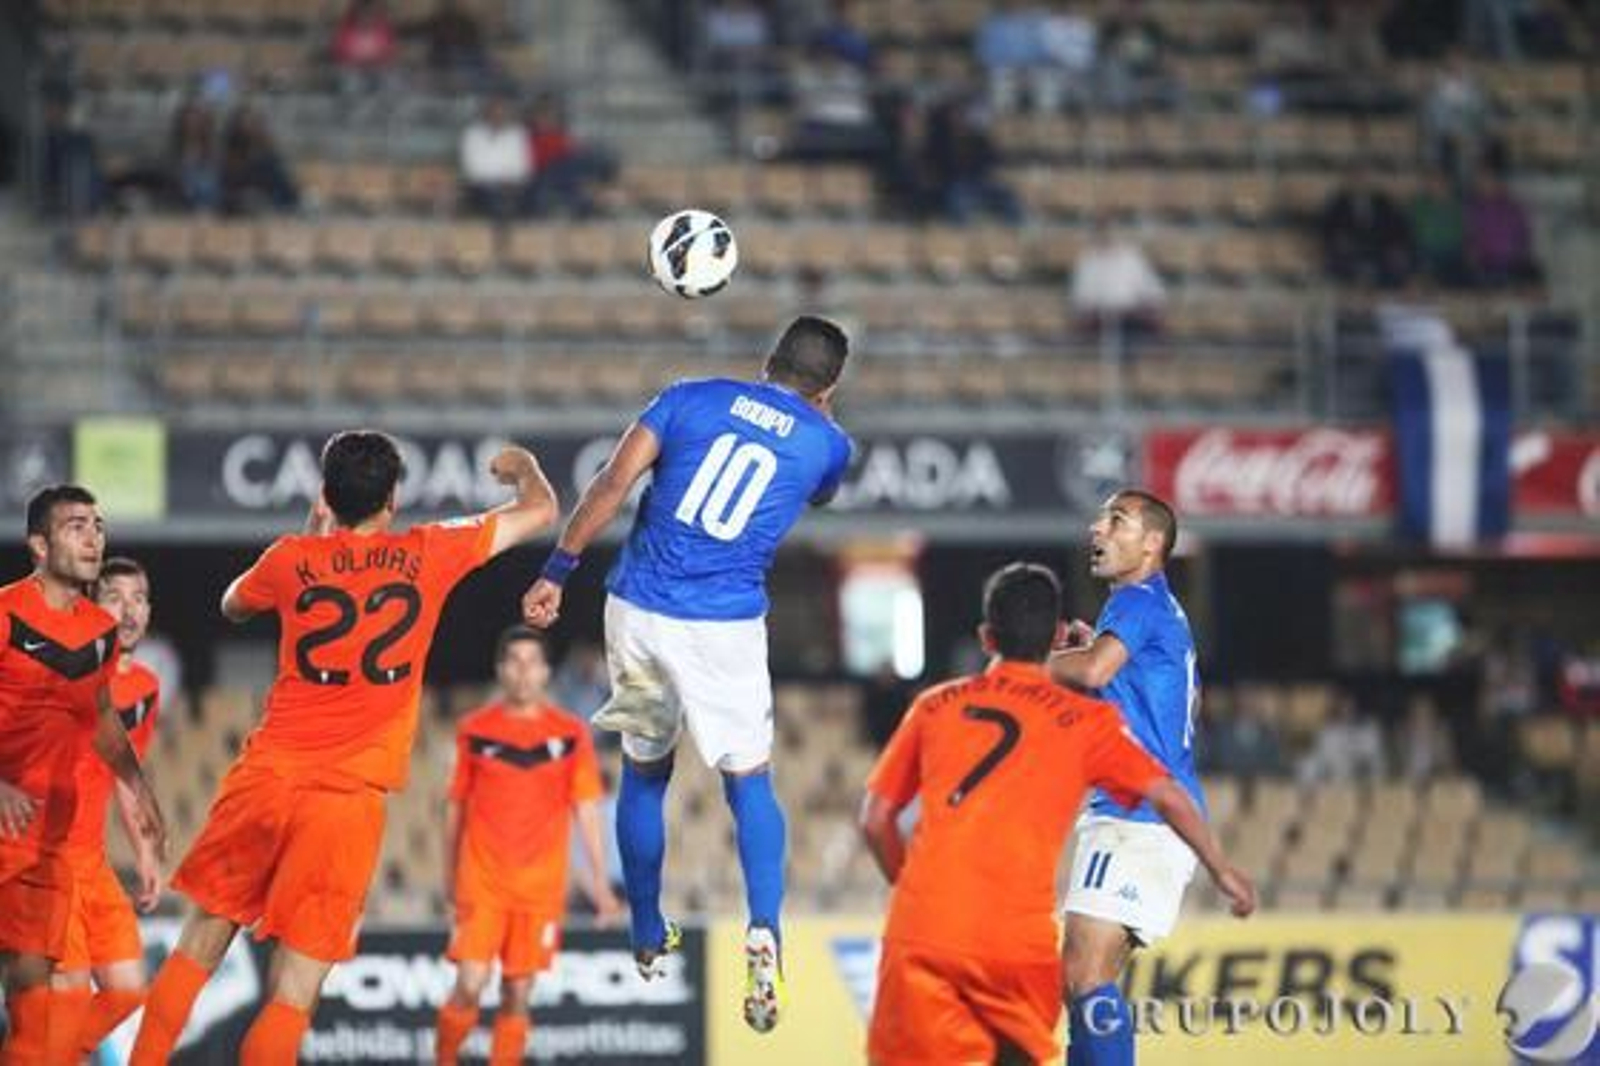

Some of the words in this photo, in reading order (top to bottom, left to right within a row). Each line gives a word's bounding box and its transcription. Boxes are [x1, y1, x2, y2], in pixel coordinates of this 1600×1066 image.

[676, 433, 777, 542] 10
[295, 583, 422, 686] 22
[947, 705, 1021, 807] 7
[1084, 852, 1111, 888] 11
